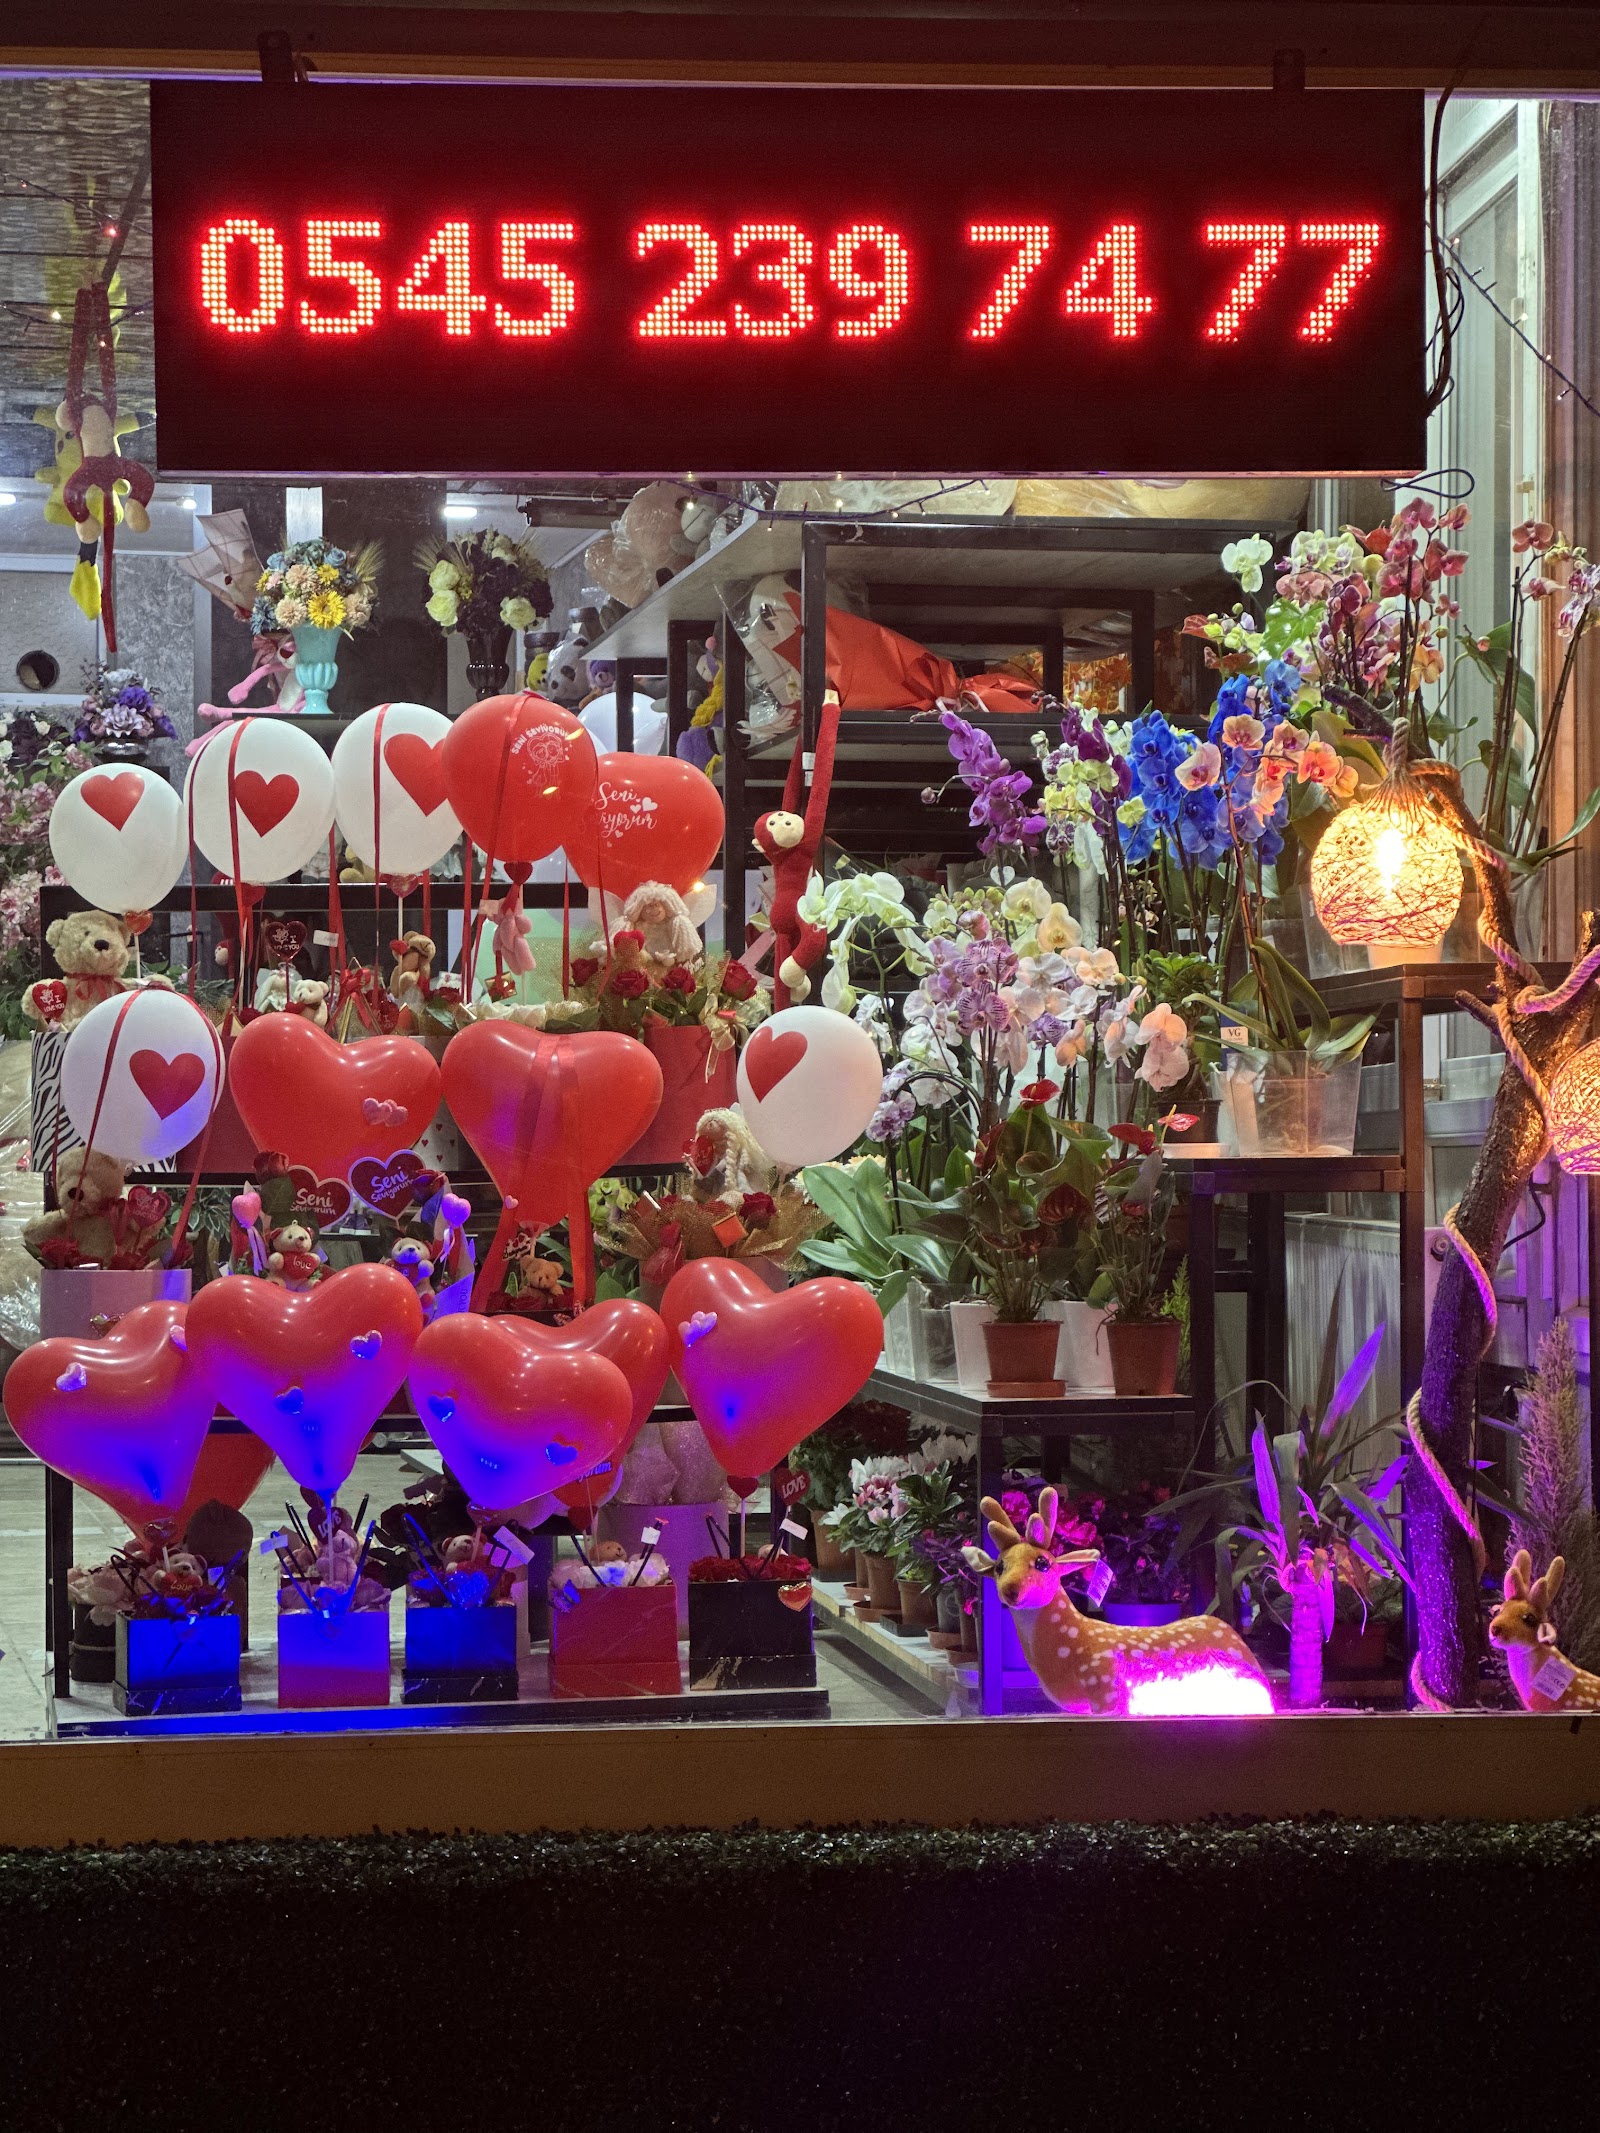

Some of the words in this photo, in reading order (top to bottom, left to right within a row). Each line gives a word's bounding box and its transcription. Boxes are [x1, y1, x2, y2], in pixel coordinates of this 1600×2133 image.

[199, 217, 577, 338] 0545
[635, 221, 909, 339] 239
[967, 222, 1155, 340] 74
[1204, 221, 1383, 344] 77
[594, 782, 638, 810] Seni
[1228, 1028, 1241, 1037] VG
[370, 1166, 409, 1194] Seni
[296, 1187, 334, 1207] Seni
[293, 1256, 312, 1270] love
[781, 1474, 806, 1499] LOVE
